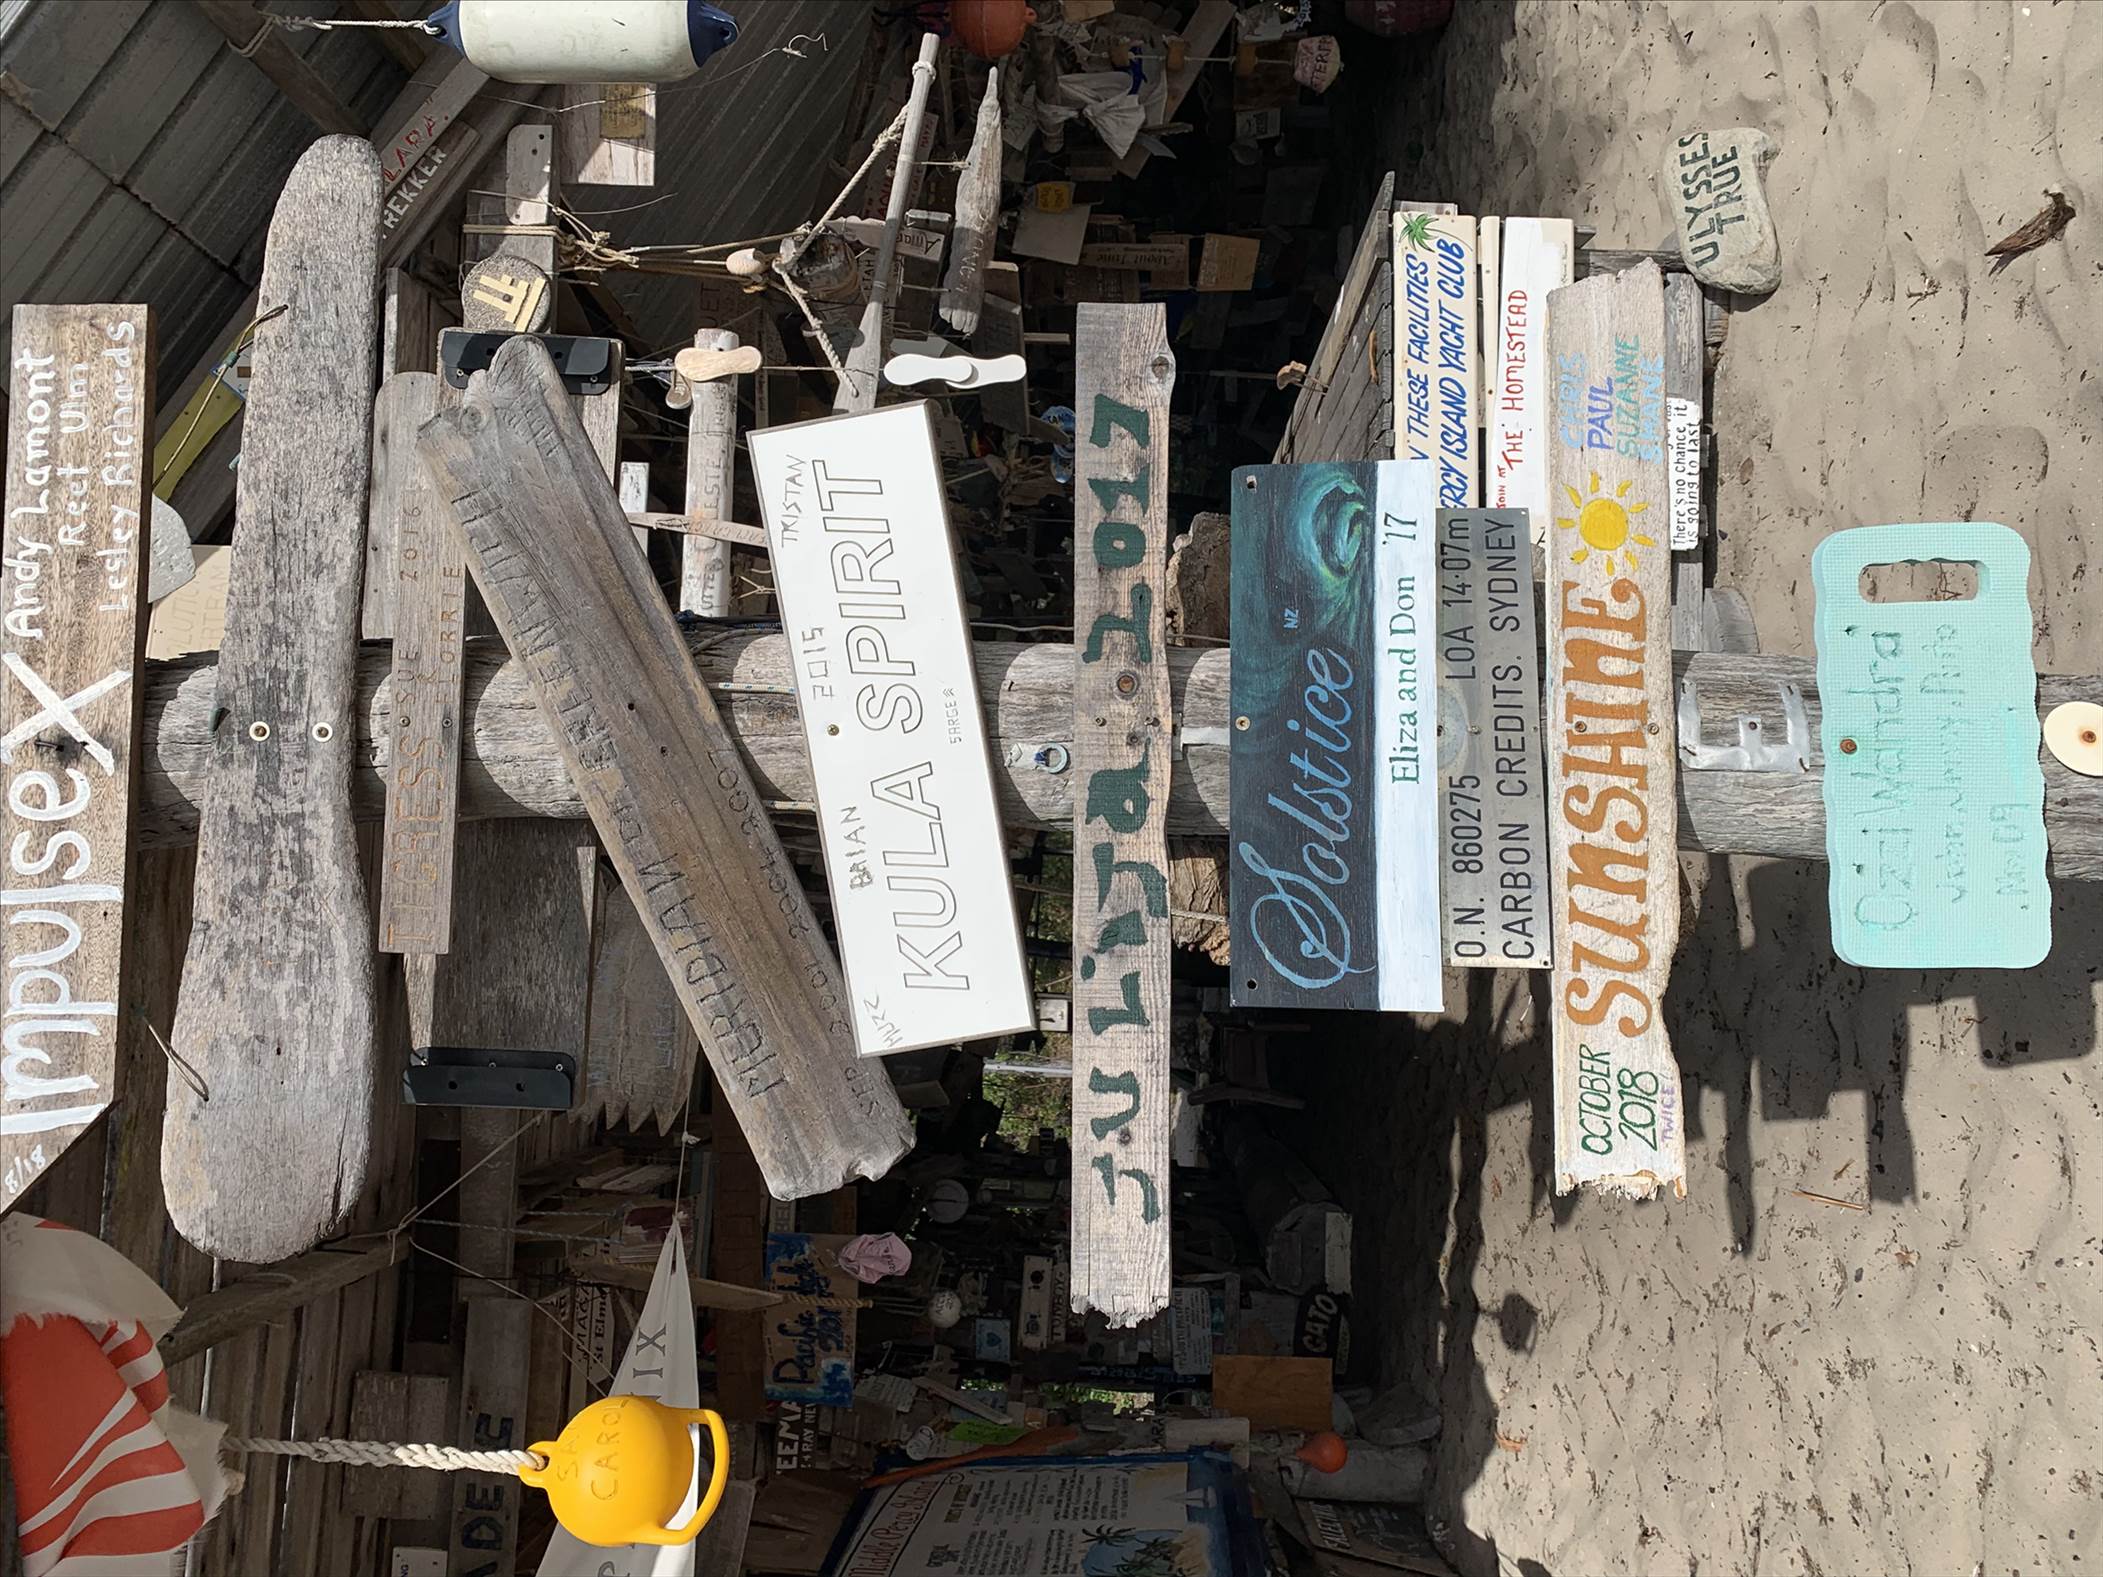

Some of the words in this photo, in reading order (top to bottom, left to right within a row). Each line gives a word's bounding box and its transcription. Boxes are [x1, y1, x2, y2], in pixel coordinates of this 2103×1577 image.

[382, 145, 447, 239] REKKER
[1676, 132, 1722, 268] ULYSSES
[1711, 146, 1747, 229] TRUE
[1405, 252, 1430, 364] FACILITIES
[1436, 237, 1466, 299] CLUB
[1437, 298, 1468, 373] YACHT
[1501, 289, 1528, 411] HOMESTEAD
[10, 348, 55, 518] Lamont
[102, 321, 136, 486] Richards
[1406, 367, 1430, 438] THESE
[1437, 377, 1468, 460] ISLAND
[1558, 352, 1588, 447] CHRIS
[1587, 376, 1613, 450] PAUL
[1614, 332, 1641, 459] SUZANNE
[1637, 352, 1665, 464] SHANE
[1673, 404, 1688, 417] it
[1502, 429, 1524, 471] THE
[1674, 426, 1686, 473] chance
[1675, 478, 1686, 494] no
[1686, 459, 1697, 476] to
[780, 454, 807, 549] TRISTAN
[1080, 394, 1151, 664] 2017
[1382, 511, 1419, 546] '17
[1672, 498, 1687, 546] There's
[1686, 530, 1697, 543] is
[1687, 481, 1699, 524] going
[97, 505, 138, 611] Lesley
[400, 506, 421, 582] 2016
[1484, 517, 1521, 632] SYDNEY
[4, 536, 53, 639] Andy
[812, 459, 924, 735] SPIRIT
[1284, 608, 1299, 629] NZ
[1389, 575, 1418, 637] Don
[436, 566, 460, 705] FLORRIE
[801, 626, 834, 699] 2015
[1389, 647, 1418, 702] and
[1441, 625, 1476, 680] LOA
[395, 649, 418, 706] SUE
[944, 699, 963, 744] SARGE
[1389, 710, 1421, 785] Eliza
[706, 746, 760, 835] 2007
[1238, 647, 1376, 990] Solstice
[1447, 774, 1481, 875] 860275
[1561, 577, 1653, 1038] SUNSHINE
[386, 733, 445, 947] TIGRESS
[870, 761, 969, 991] KULA
[760, 846, 808, 939] 2004
[1453, 896, 1487, 959] O.N.
[1497, 821, 1535, 959] CARBON
[638, 853, 787, 1098] MERIDIAN
[804, 960, 850, 1035] 2001
[843, 1066, 882, 1117] SEP
[1577, 1043, 1613, 1155] OCTOBER
[1617, 1067, 1660, 1151] 2018
